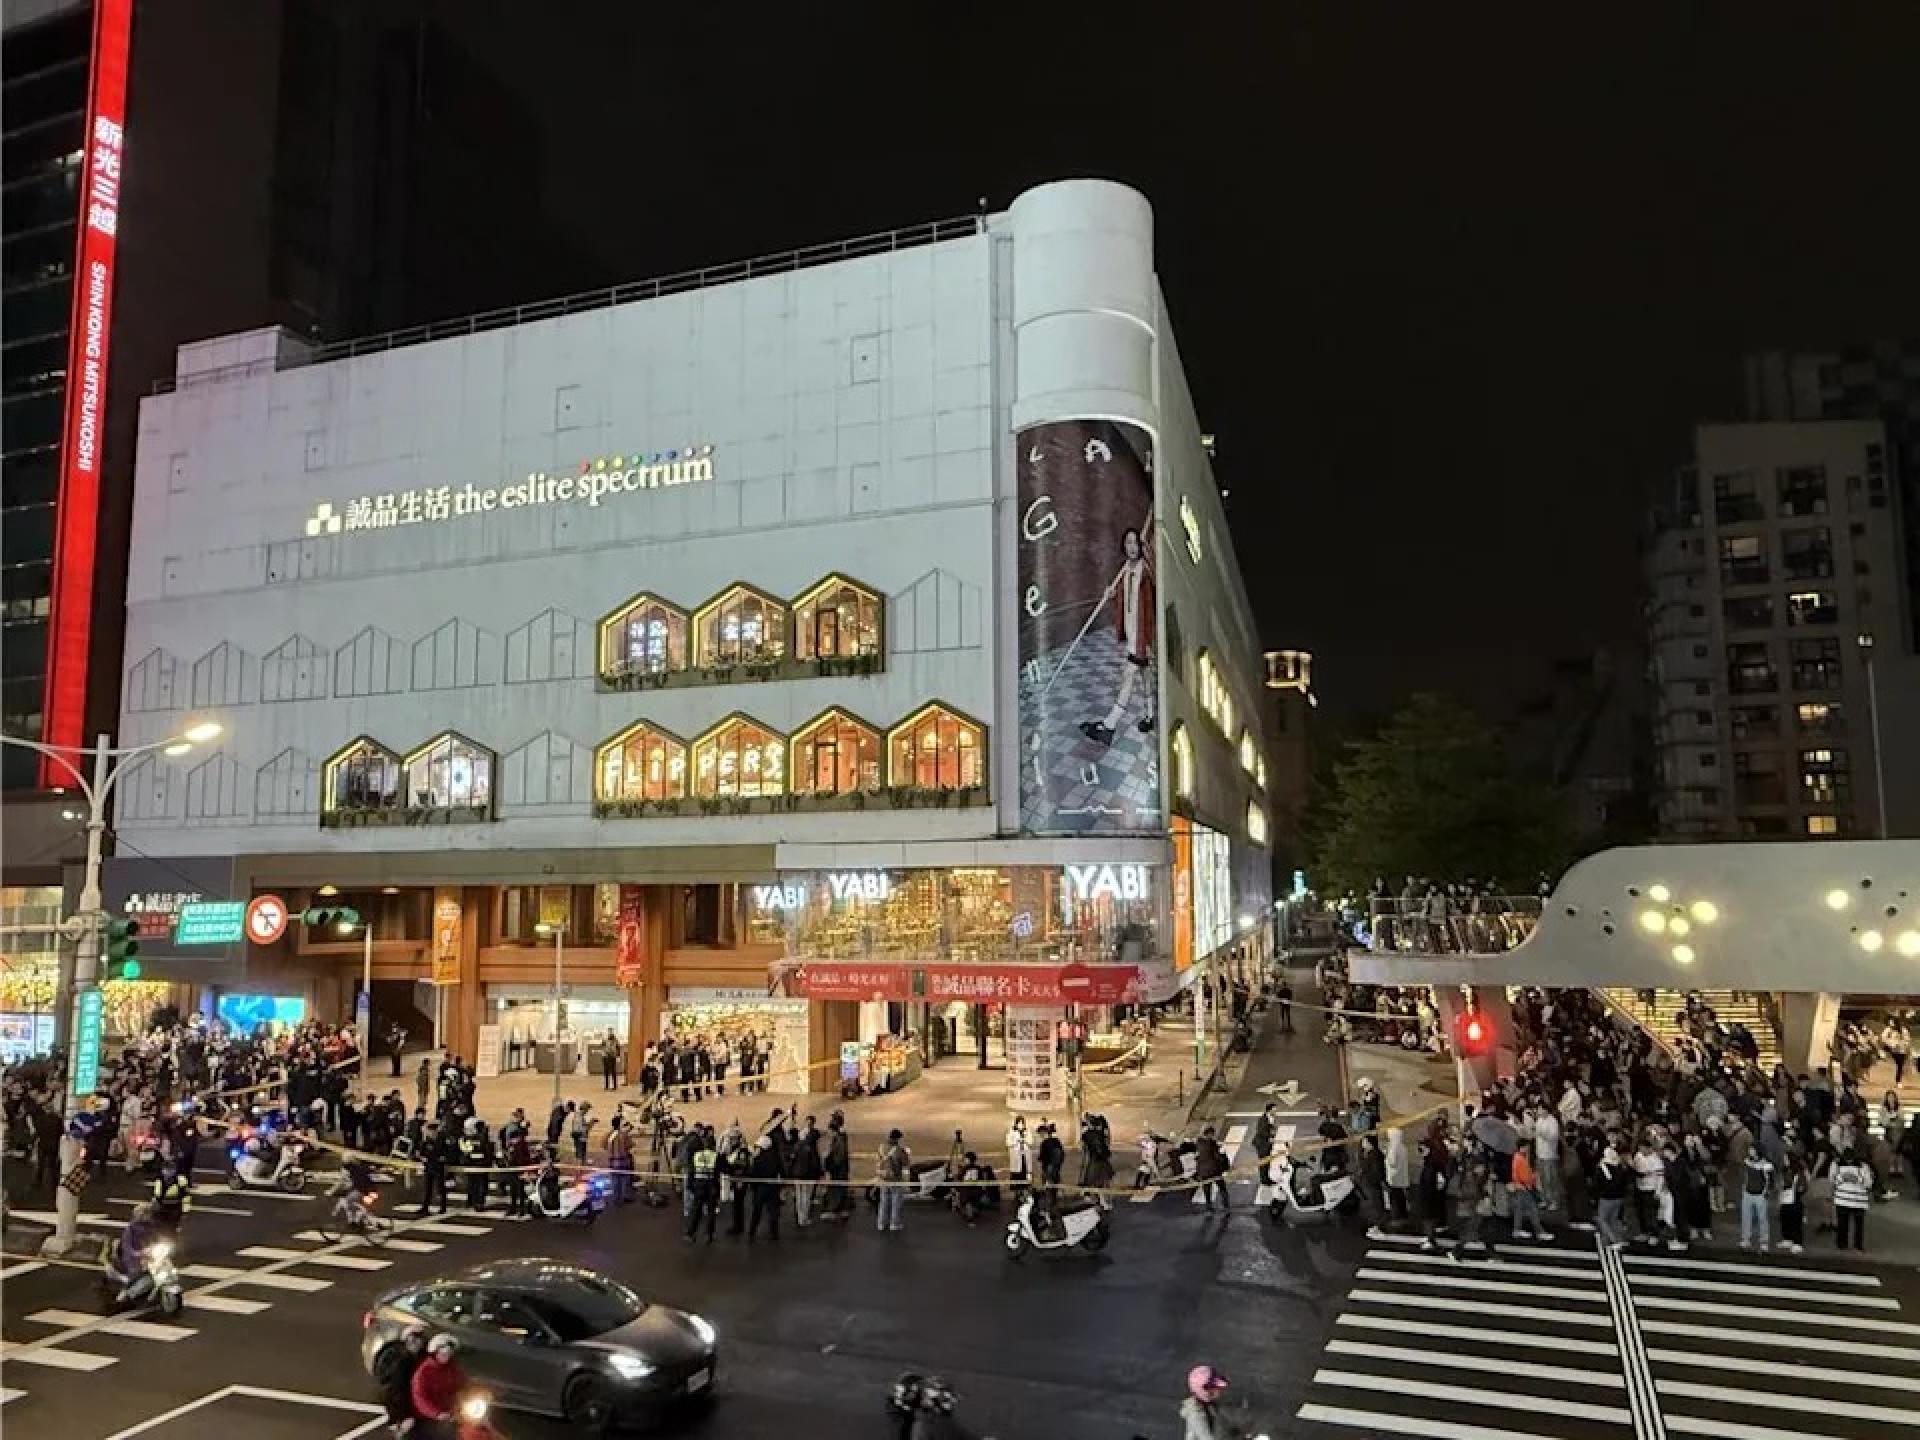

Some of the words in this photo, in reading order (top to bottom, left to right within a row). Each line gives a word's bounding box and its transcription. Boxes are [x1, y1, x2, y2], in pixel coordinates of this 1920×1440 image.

[88, 115, 122, 236] 新光三越
[86, 261, 106, 358] SHINKONG
[78, 359, 99, 472] MITSUKOSHI
[346, 486, 450, 530] 誠品生活
[455, 483, 497, 515] the
[500, 472, 573, 508] eslite
[576, 455, 713, 506] spectrum
[754, 886, 804, 909] YABI
[829, 873, 887, 899] YABI
[1067, 865, 1147, 900] YABI
